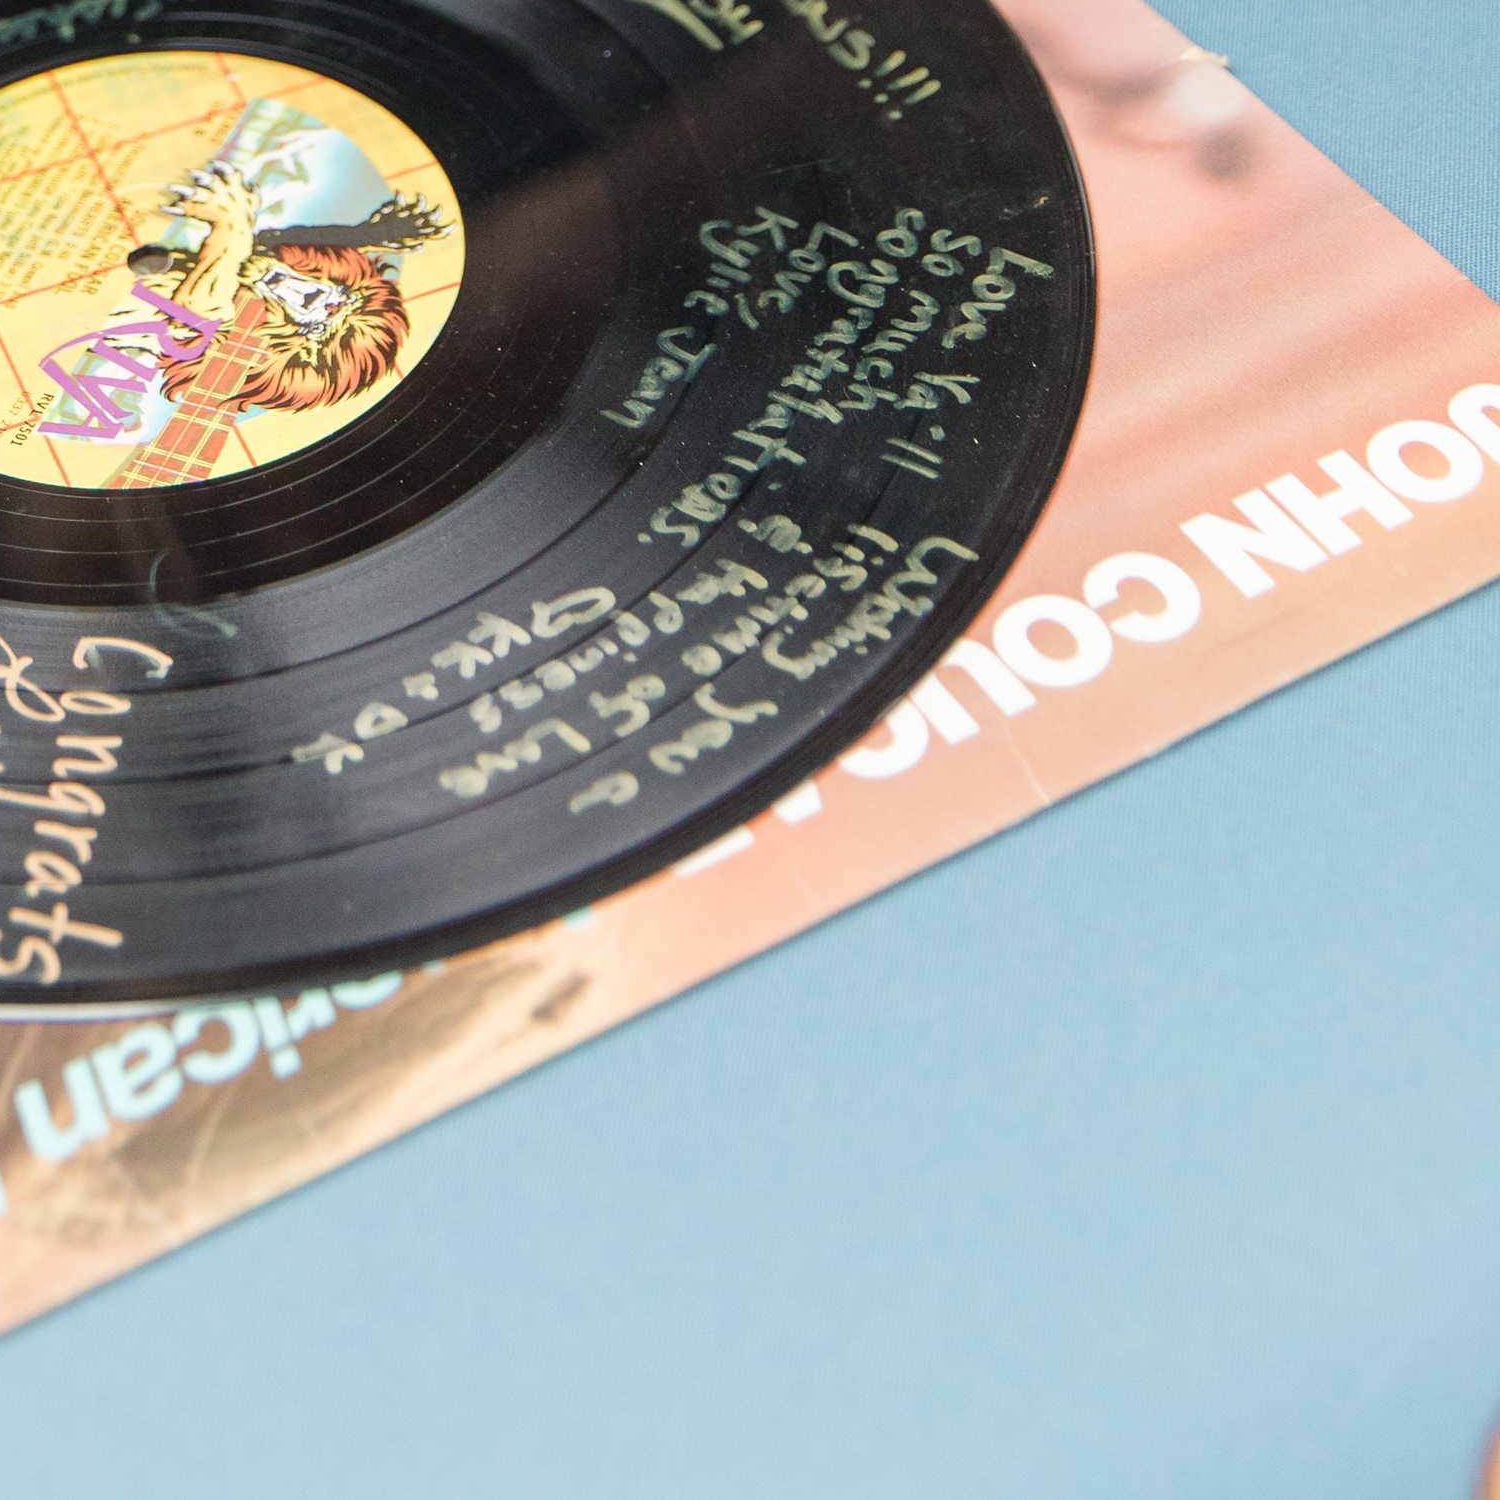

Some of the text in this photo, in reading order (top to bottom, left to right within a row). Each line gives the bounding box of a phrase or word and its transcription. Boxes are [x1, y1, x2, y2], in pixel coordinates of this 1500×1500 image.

[54, 196, 135, 297] AMERICAN FOOL
[79, 243, 126, 295] COUGAR
[601, 206, 799, 428] Kylie Jean
[838, 229, 981, 411] so much
[941, 248, 1054, 349] Love
[8, 392, 56, 446] RVL 7501
[38, 280, 223, 439] RIVA
[439, 525, 899, 797] lifetime of Love
[470, 515, 813, 733] & Happiness
[570, 536, 979, 813] Wishing you a
